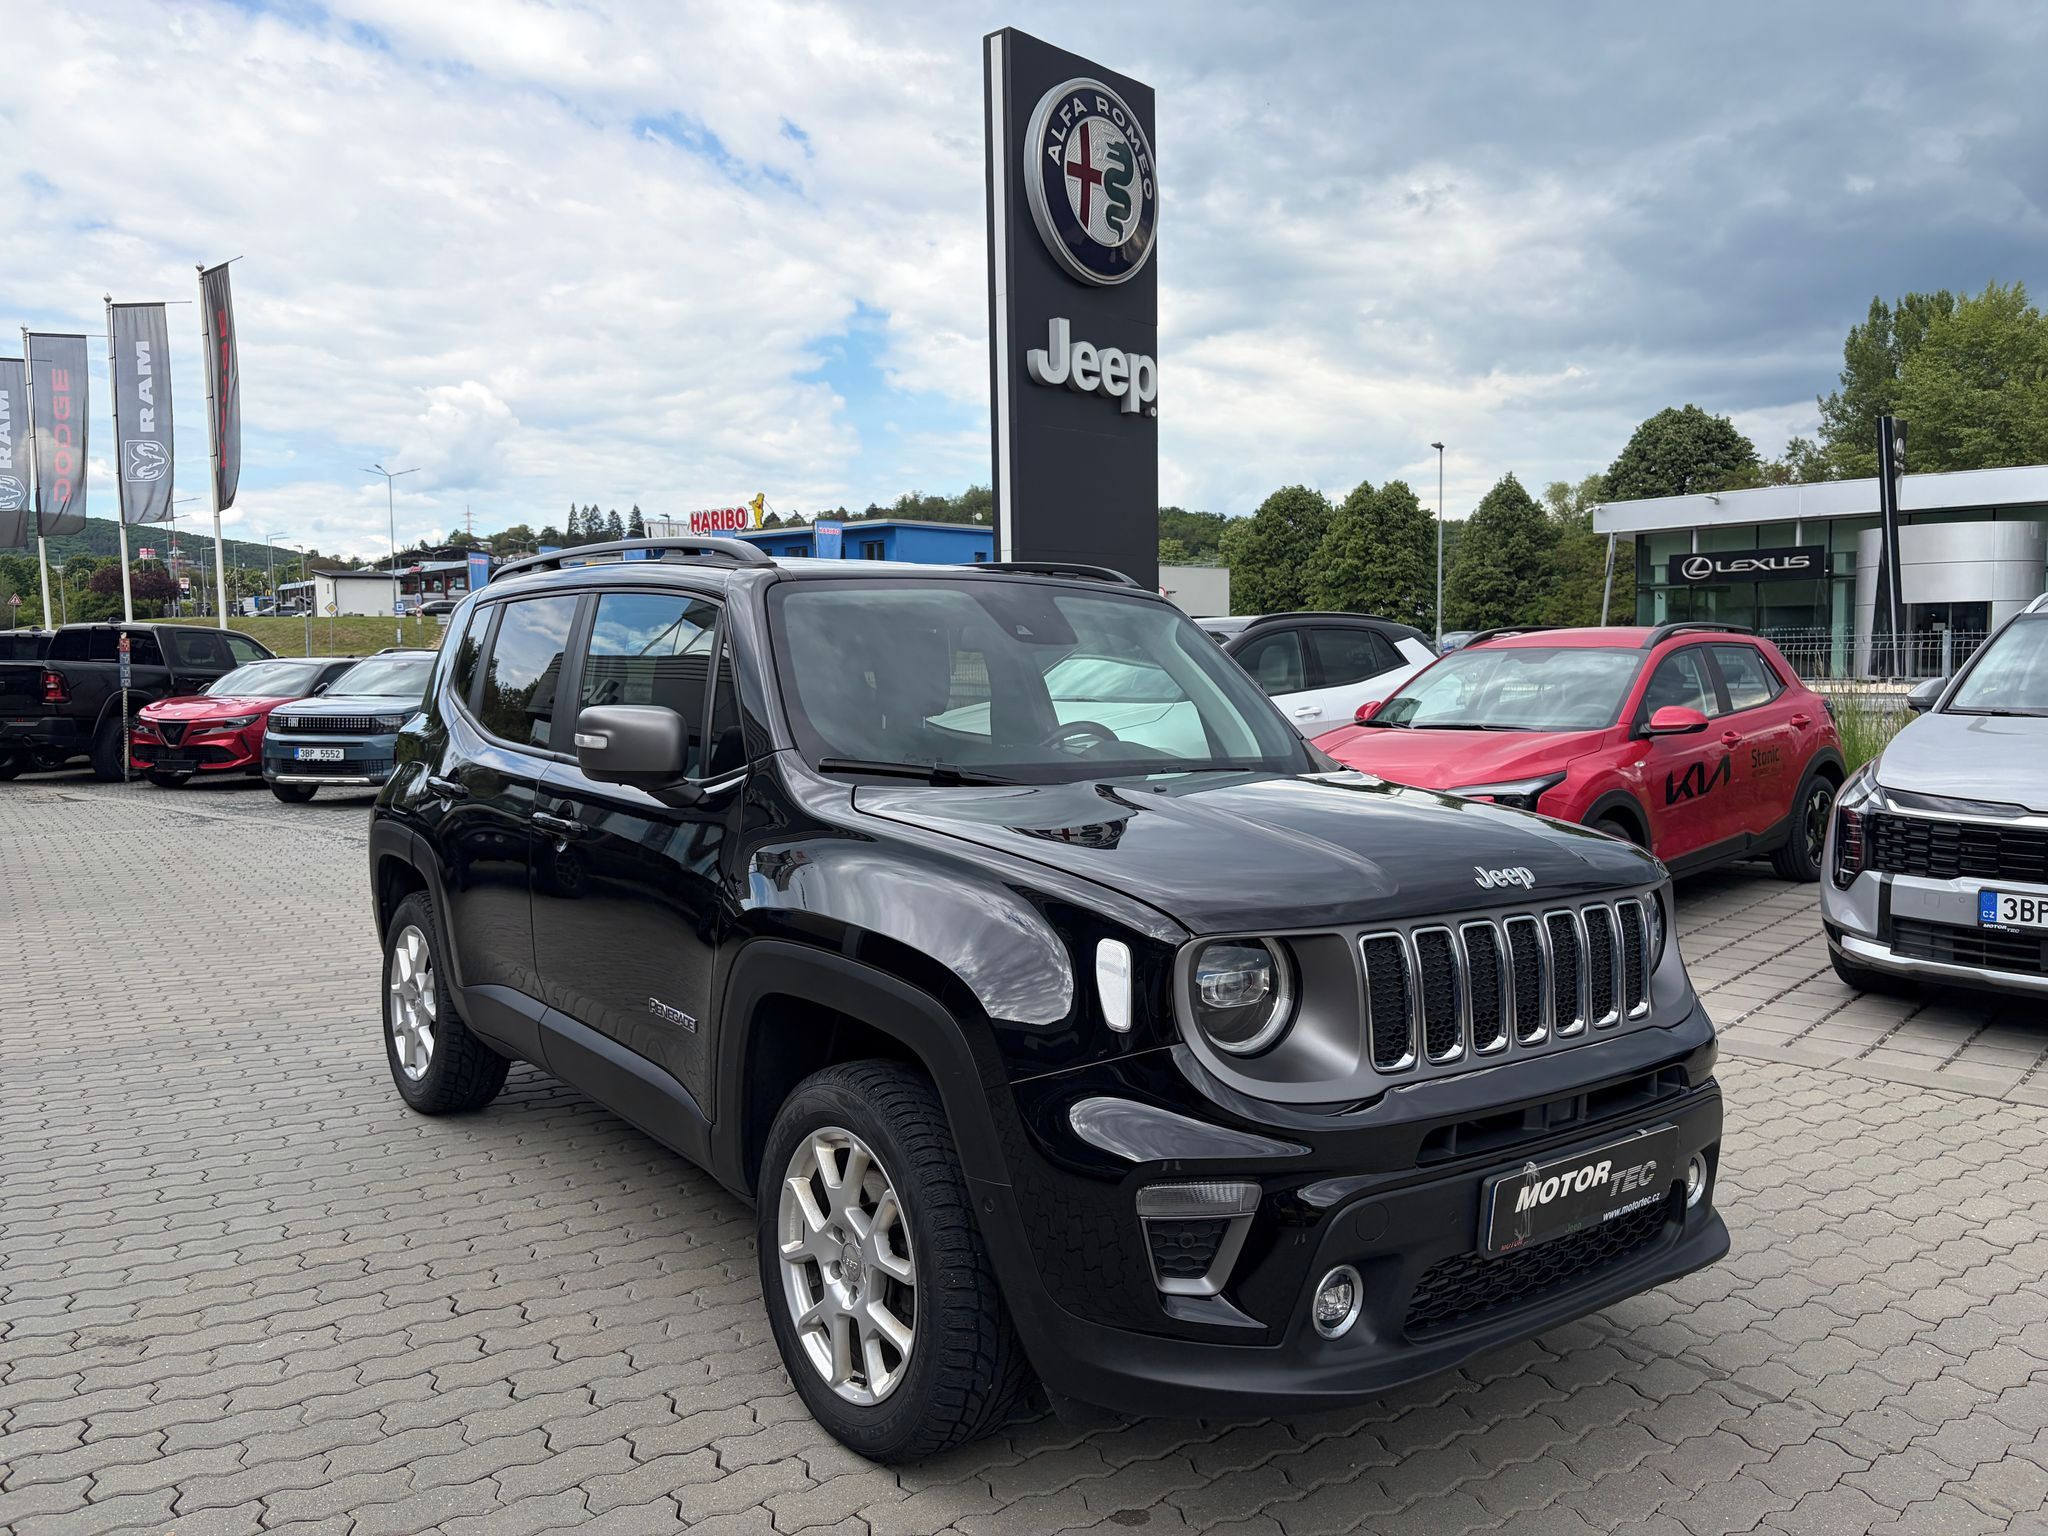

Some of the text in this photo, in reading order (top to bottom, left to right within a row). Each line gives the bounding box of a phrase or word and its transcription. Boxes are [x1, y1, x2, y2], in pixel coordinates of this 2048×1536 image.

[1047, 95, 1153, 200] ALFA ROMEO
[1026, 317, 1157, 413] Jeep
[135, 341, 155, 433] RAM
[52, 368, 74, 504] DODGE
[690, 506, 747, 533] HARIBO
[818, 527, 841, 535] HARIBO
[1715, 555, 1811, 573] LEXUS
[288, 717, 299, 727] FIAT
[300, 750, 314, 758] 3BP
[320, 750, 340, 758] 5552
[1751, 745, 1780, 768] Stonic
[1473, 866, 1536, 890] Jeep
[1982, 910, 1995, 919] CZ
[1603, 1192, 1660, 1221] www.motortec.cz
